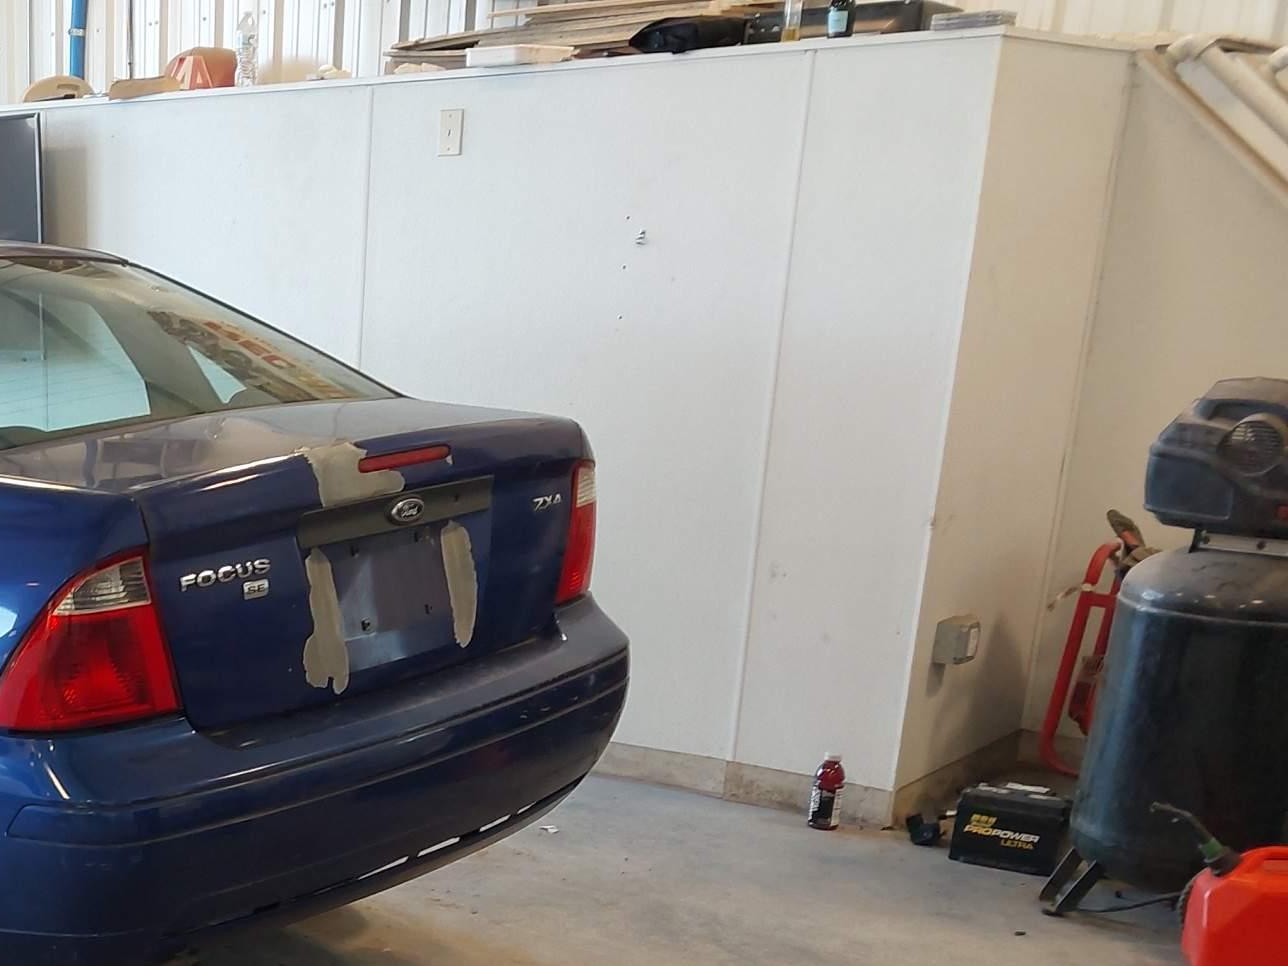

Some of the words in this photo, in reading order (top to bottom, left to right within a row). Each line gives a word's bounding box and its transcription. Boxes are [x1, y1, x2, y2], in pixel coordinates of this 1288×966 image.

[180, 558, 271, 592] FOCUS
[247, 583, 266, 595] SE
[1000, 839, 1034, 850] ULTRA
